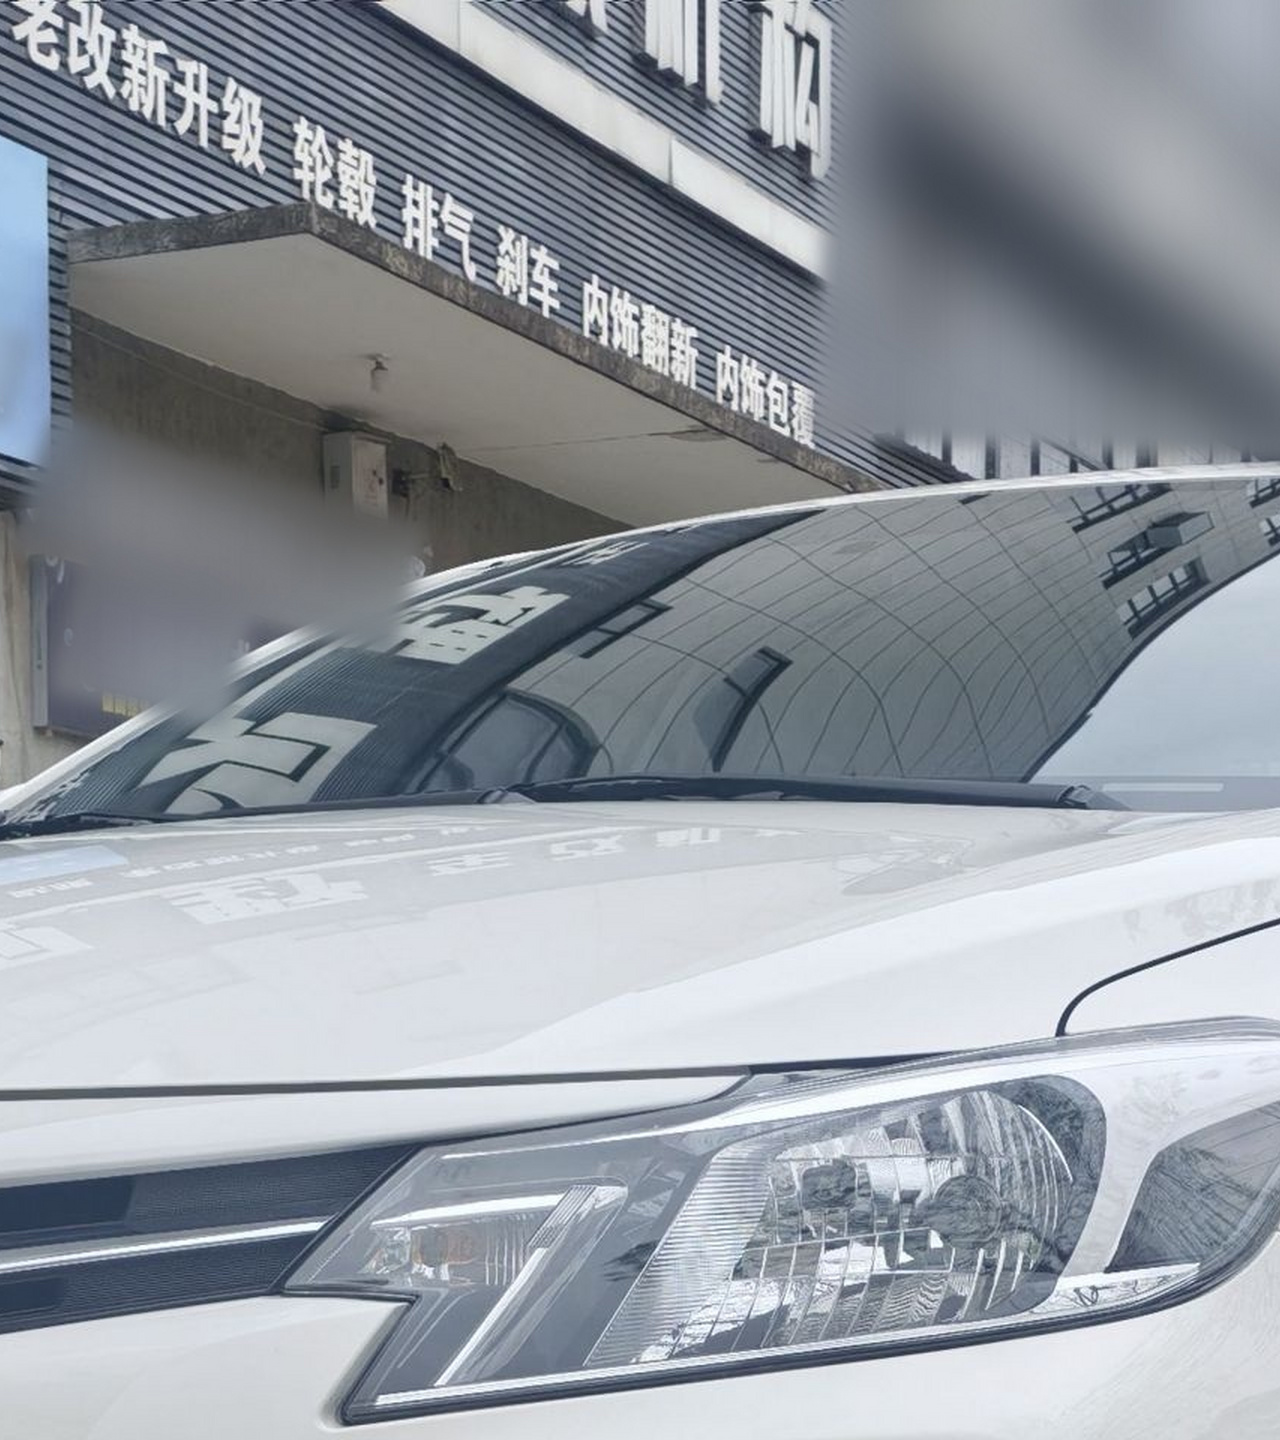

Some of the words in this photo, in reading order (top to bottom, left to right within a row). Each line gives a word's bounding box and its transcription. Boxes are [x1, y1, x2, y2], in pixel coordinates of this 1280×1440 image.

[11, 0, 266, 178] 老改新升级
[292, 115, 378, 230] 轮毂
[401, 173, 477, 283] 排气
[495, 224, 561, 318] 刹车
[581, 273, 700, 390] 内饰翻新
[715, 343, 817, 450] 内饰包覆
